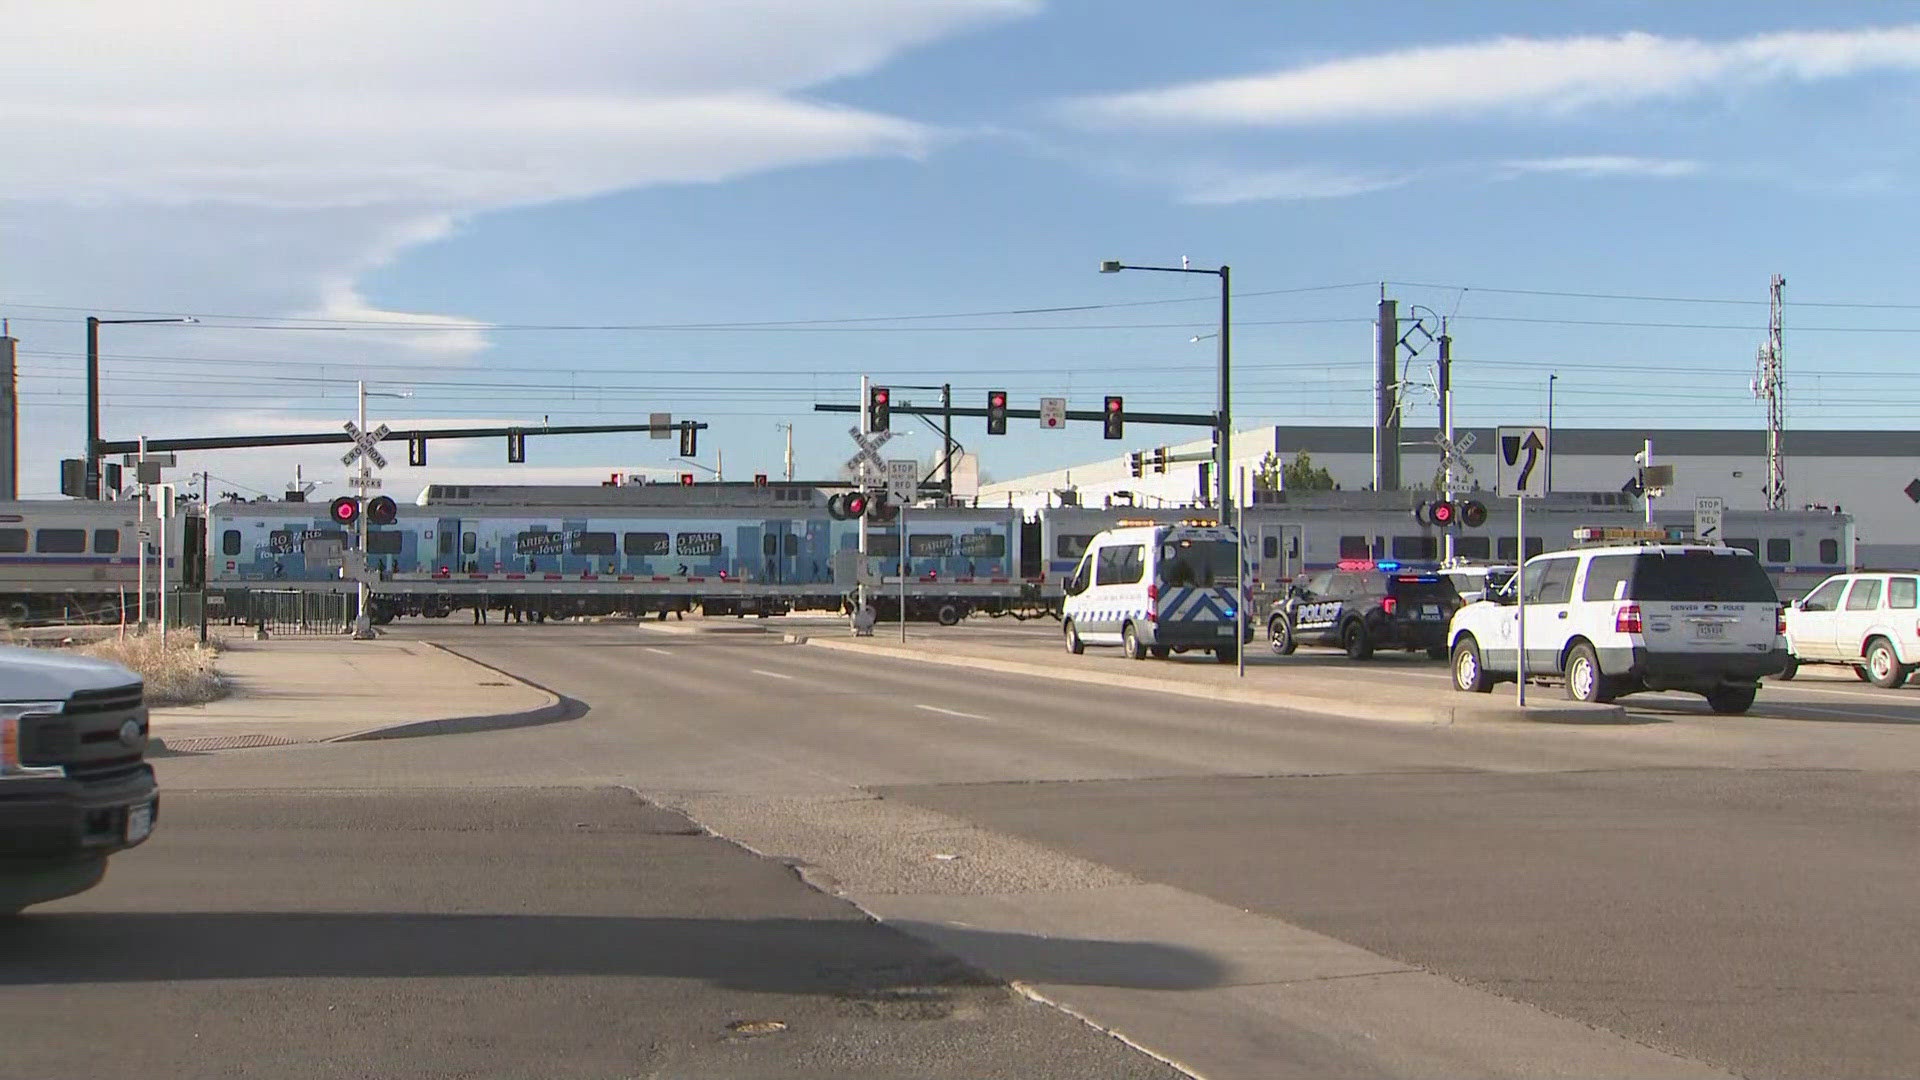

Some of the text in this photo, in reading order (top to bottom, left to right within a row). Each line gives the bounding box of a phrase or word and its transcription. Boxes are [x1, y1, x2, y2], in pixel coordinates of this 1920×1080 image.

[343, 425, 388, 465] CROSSING
[848, 430, 891, 470] CROSSING
[892, 464, 913, 473] STOP
[363, 470, 369, 478] 4
[350, 479, 381, 488] TRACKS
[895, 481, 911, 489] RED
[1699, 500, 1719, 508] STOP
[1701, 516, 1717, 525] RED
[512, 529, 582, 550] TARIFA CERO
[654, 532, 719, 552] ZEO FARE
[278, 542, 303, 554] You
[678, 541, 715, 556] Youth
[1297, 602, 1342, 623] POLICE
[1670, 604, 1698, 612] DENVER
[1723, 604, 1745, 612] POLICE
